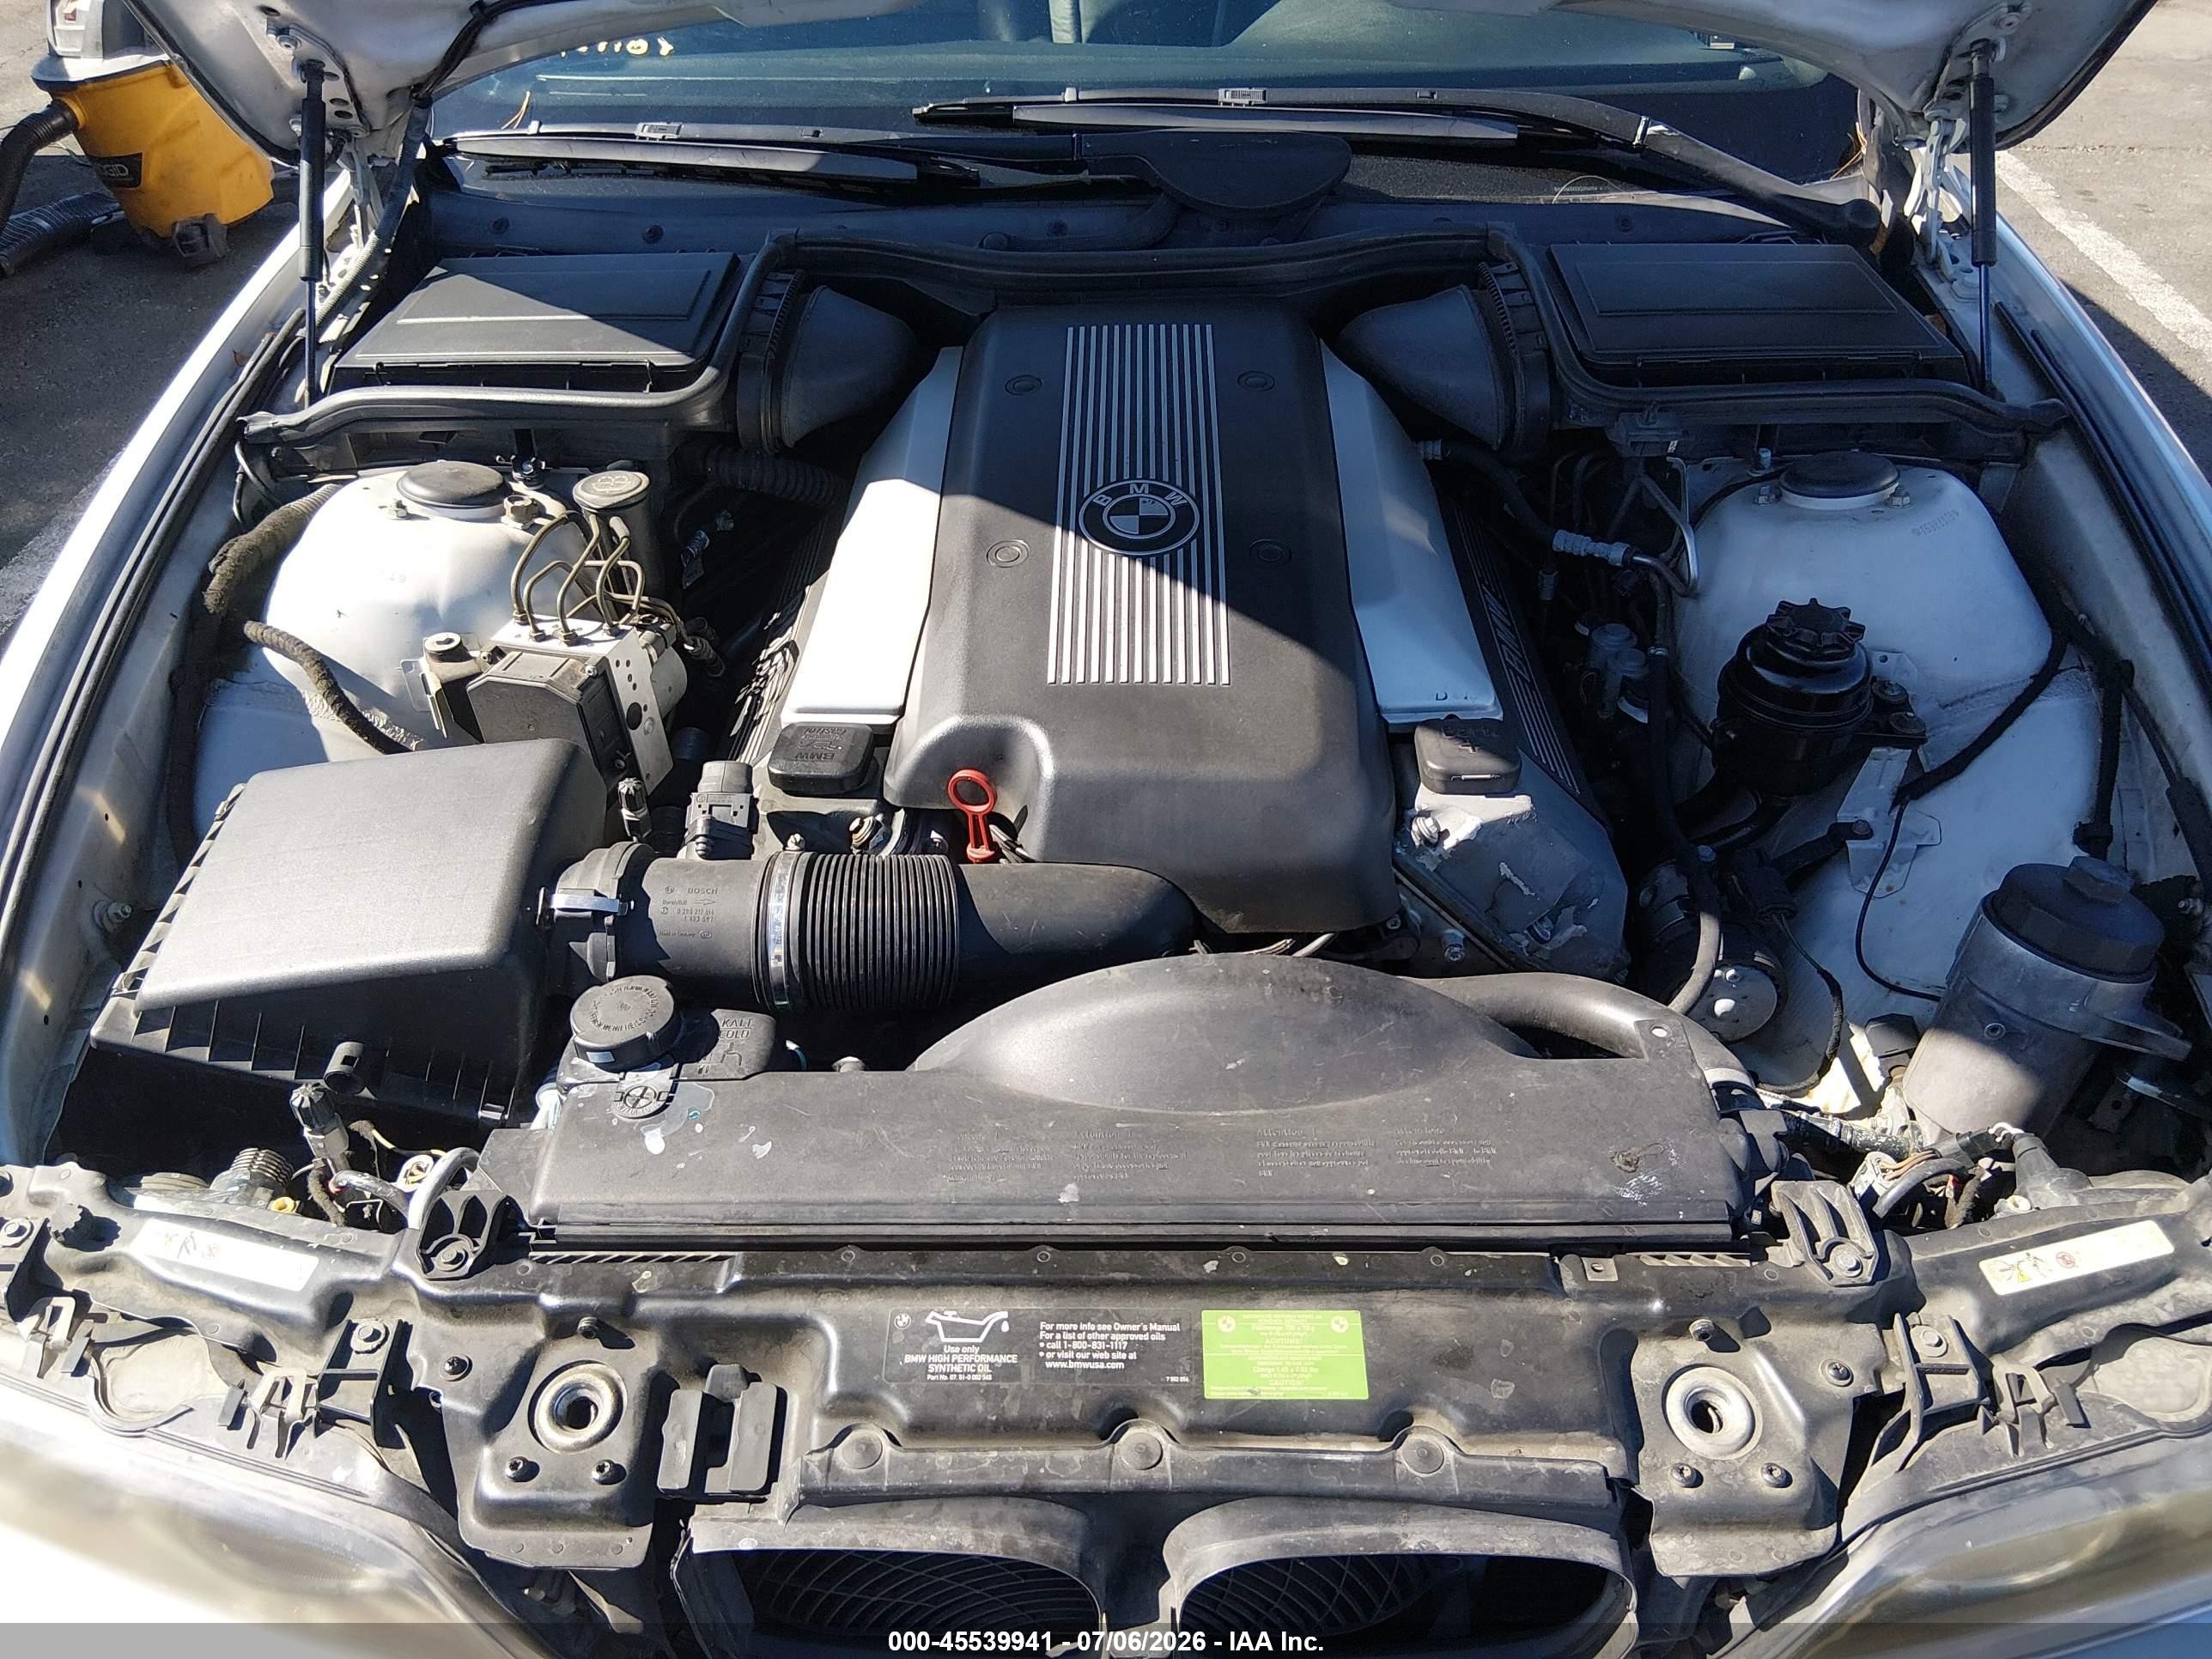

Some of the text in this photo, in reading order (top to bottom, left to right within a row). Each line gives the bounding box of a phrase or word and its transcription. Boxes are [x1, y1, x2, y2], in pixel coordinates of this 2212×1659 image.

[1092, 483, 1188, 507] BMW
[721, 1018, 755, 1027] KALT
[1040, 1331, 1054, 1340] For
[1063, 1331, 1076, 1340] list
[1078, 1331, 1086, 1340] of
[1087, 1331, 1109, 1340] other
[1110, 1333, 1148, 1341] approved
[1150, 1332, 1165, 1340] oils
[905, 1354, 1018, 1363] BMW HIGH PERFORMANCE
[928, 1364, 992, 1372] SYNTHETIC OIL
